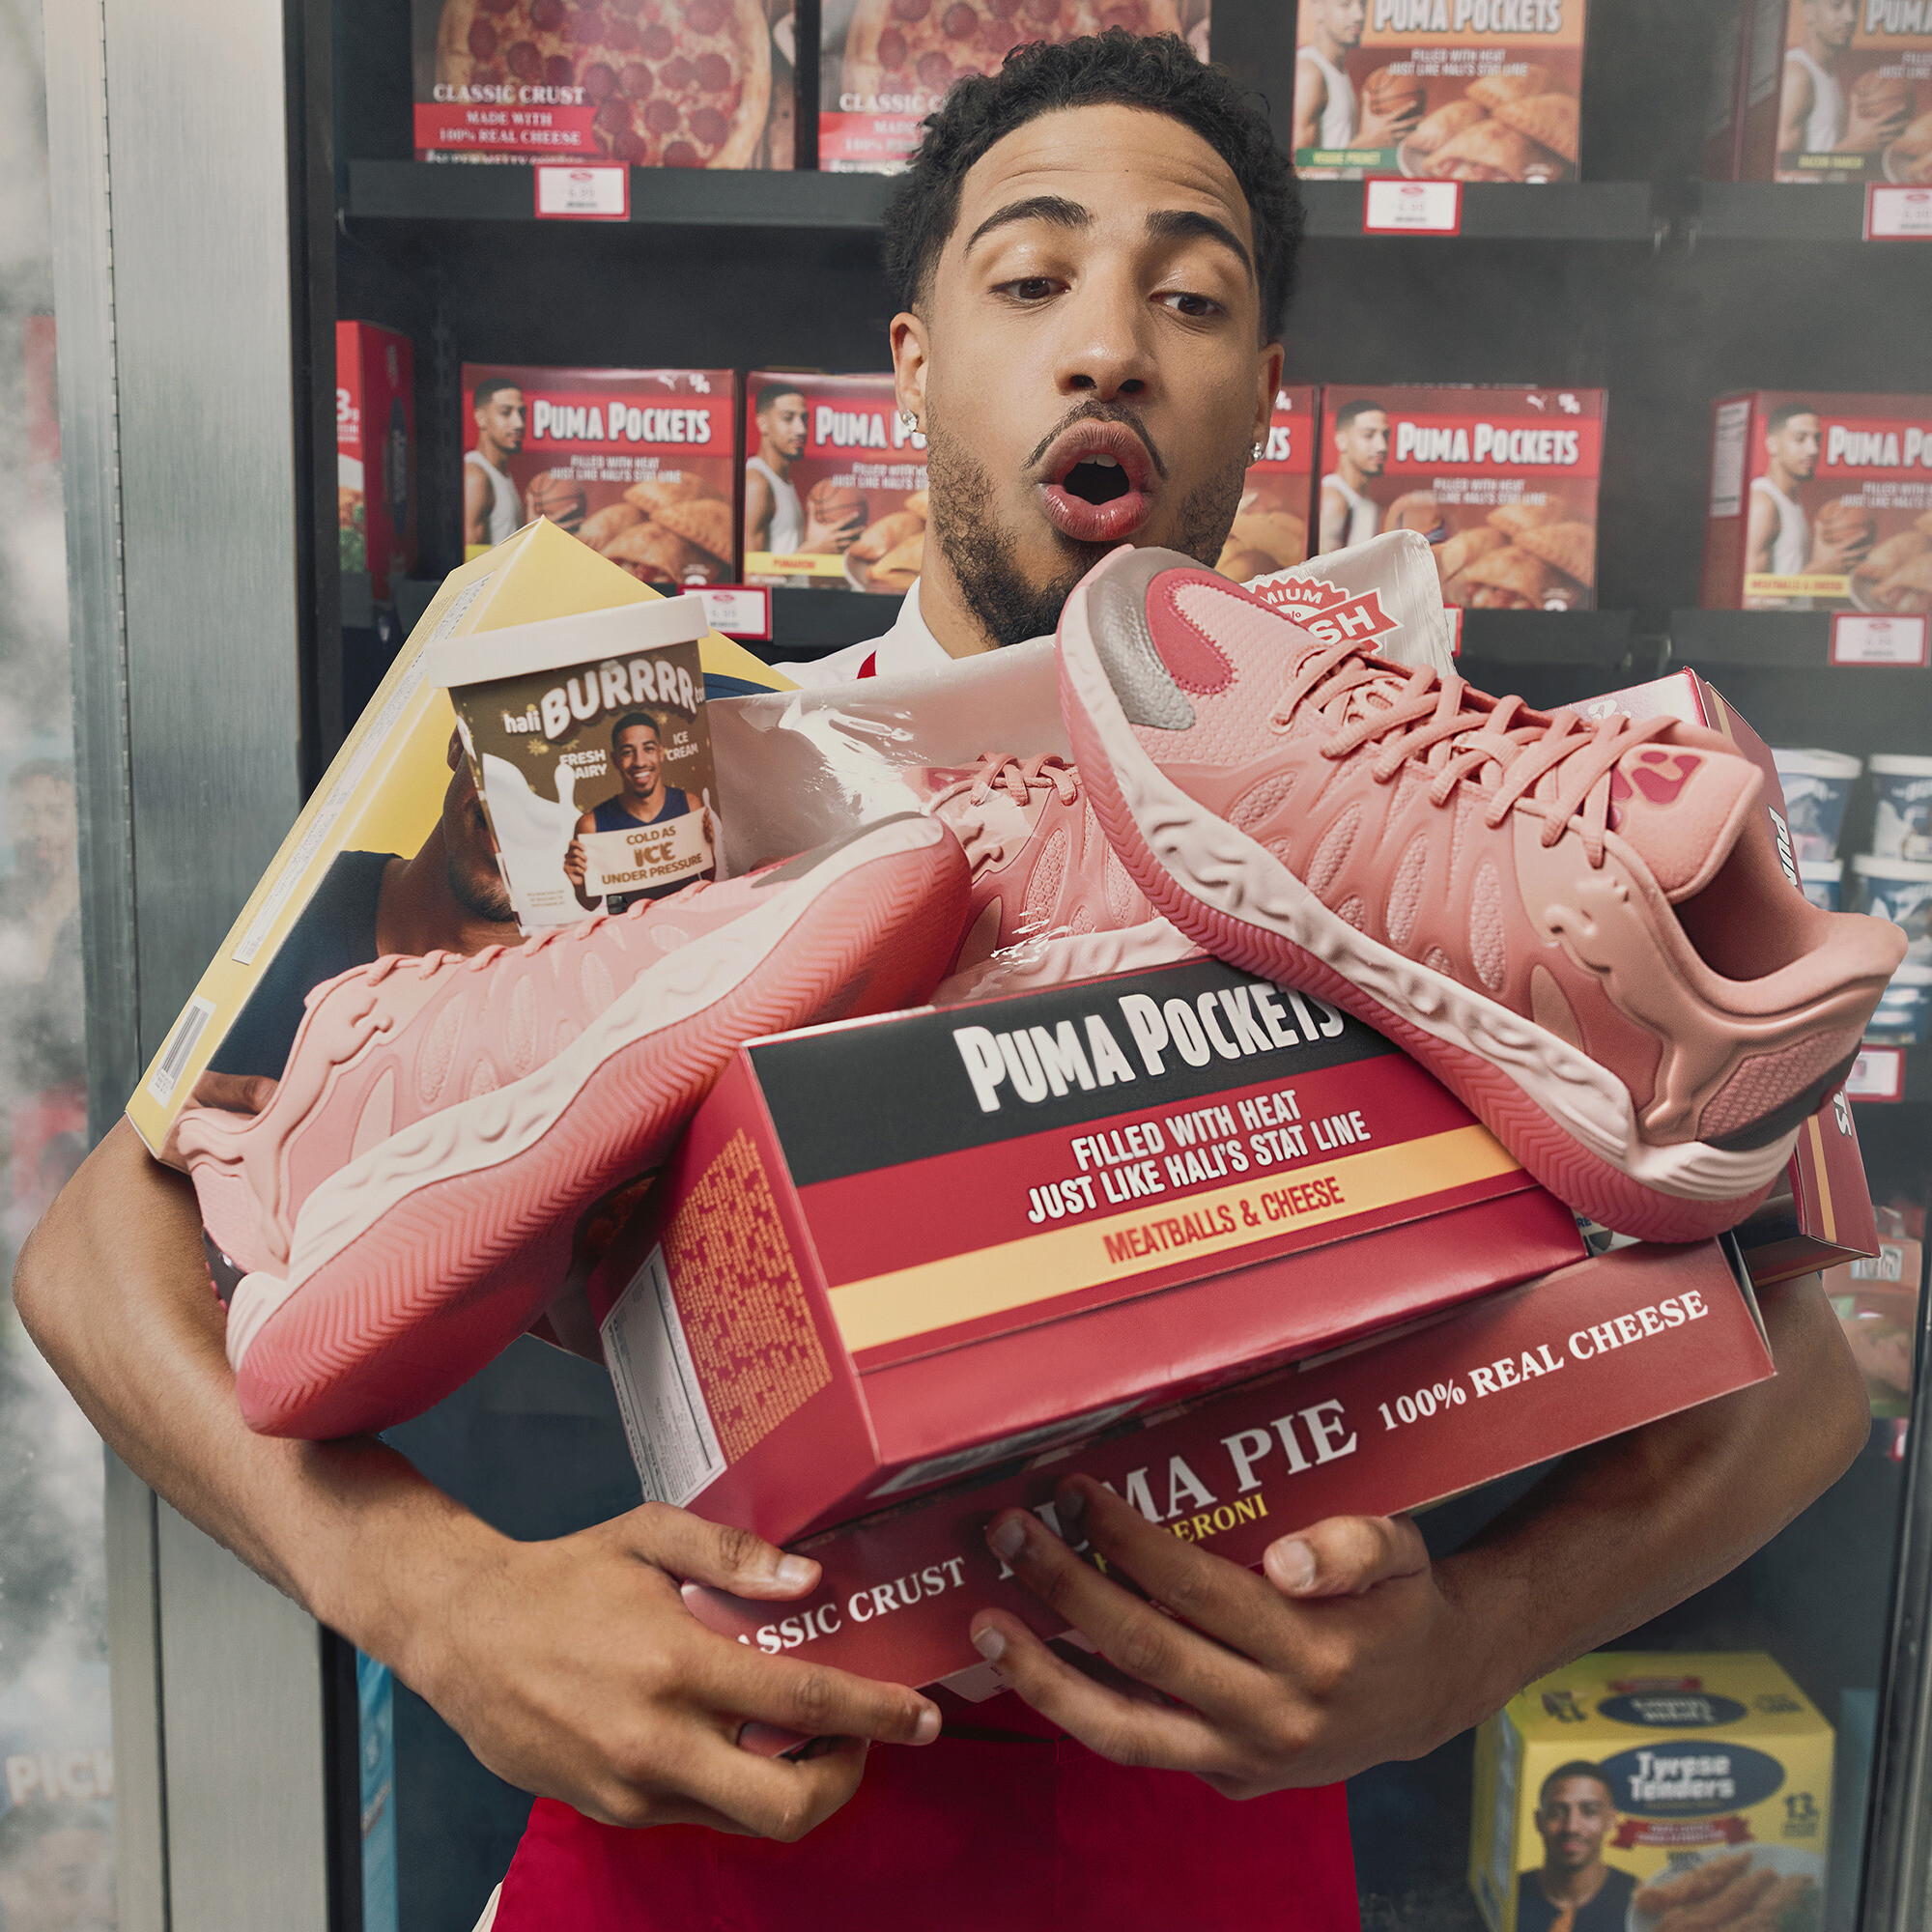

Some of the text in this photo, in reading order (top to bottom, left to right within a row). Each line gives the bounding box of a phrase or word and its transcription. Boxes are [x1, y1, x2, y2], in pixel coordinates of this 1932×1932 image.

[1452, 0, 1562, 33] POCKETS
[433, 83, 586, 105] CLASSIC CRUST
[838, 93, 926, 114] CLASSIC
[466, 111, 554, 126] MADE WITH
[439, 128, 582, 146] 100% REAL CHEESE
[533, 399, 711, 444] PUMA POCKETS
[814, 405, 889, 450] PUMA
[1396, 421, 1580, 466] PUMA POCKETS
[1827, 424, 1901, 468] PUMA
[549, 468, 575, 481] JUST
[570, 455, 661, 470] FILLED WITH HEAT
[667, 742, 699, 761] CREAM
[673, 730, 690, 746] ICE
[559, 749, 607, 768] FRESH
[570, 763, 608, 781] AIRY
[627, 825, 677, 845] COLD AS
[634, 841, 676, 867] ICE
[602, 852, 703, 886] UNDER PRESSURE
[952, 981, 1345, 1113] PUMA POCKETS
[1070, 1089, 1303, 1173] FILLED WITH HEAT
[1027, 1175, 1098, 1224] JUST
[1104, 1158, 1166, 1205] LIKE
[1254, 1124, 1309, 1167] STAT
[1311, 1110, 1372, 1151] LINE
[1102, 1176, 1346, 1265] MEATBALLS & CHEESE
[738, 1604, 841, 1655] SSIC
[848, 1555, 965, 1623] CRUST
[1220, 1396, 1358, 1493] PIE
[1378, 1378, 1466, 1433] 100%
[1467, 1343, 1565, 1398] REAL
[1567, 1289, 1709, 1360] CHEESE
[1635, 1750, 1731, 1786] Tyrese
[1628, 1775, 1736, 1803] Tenders
